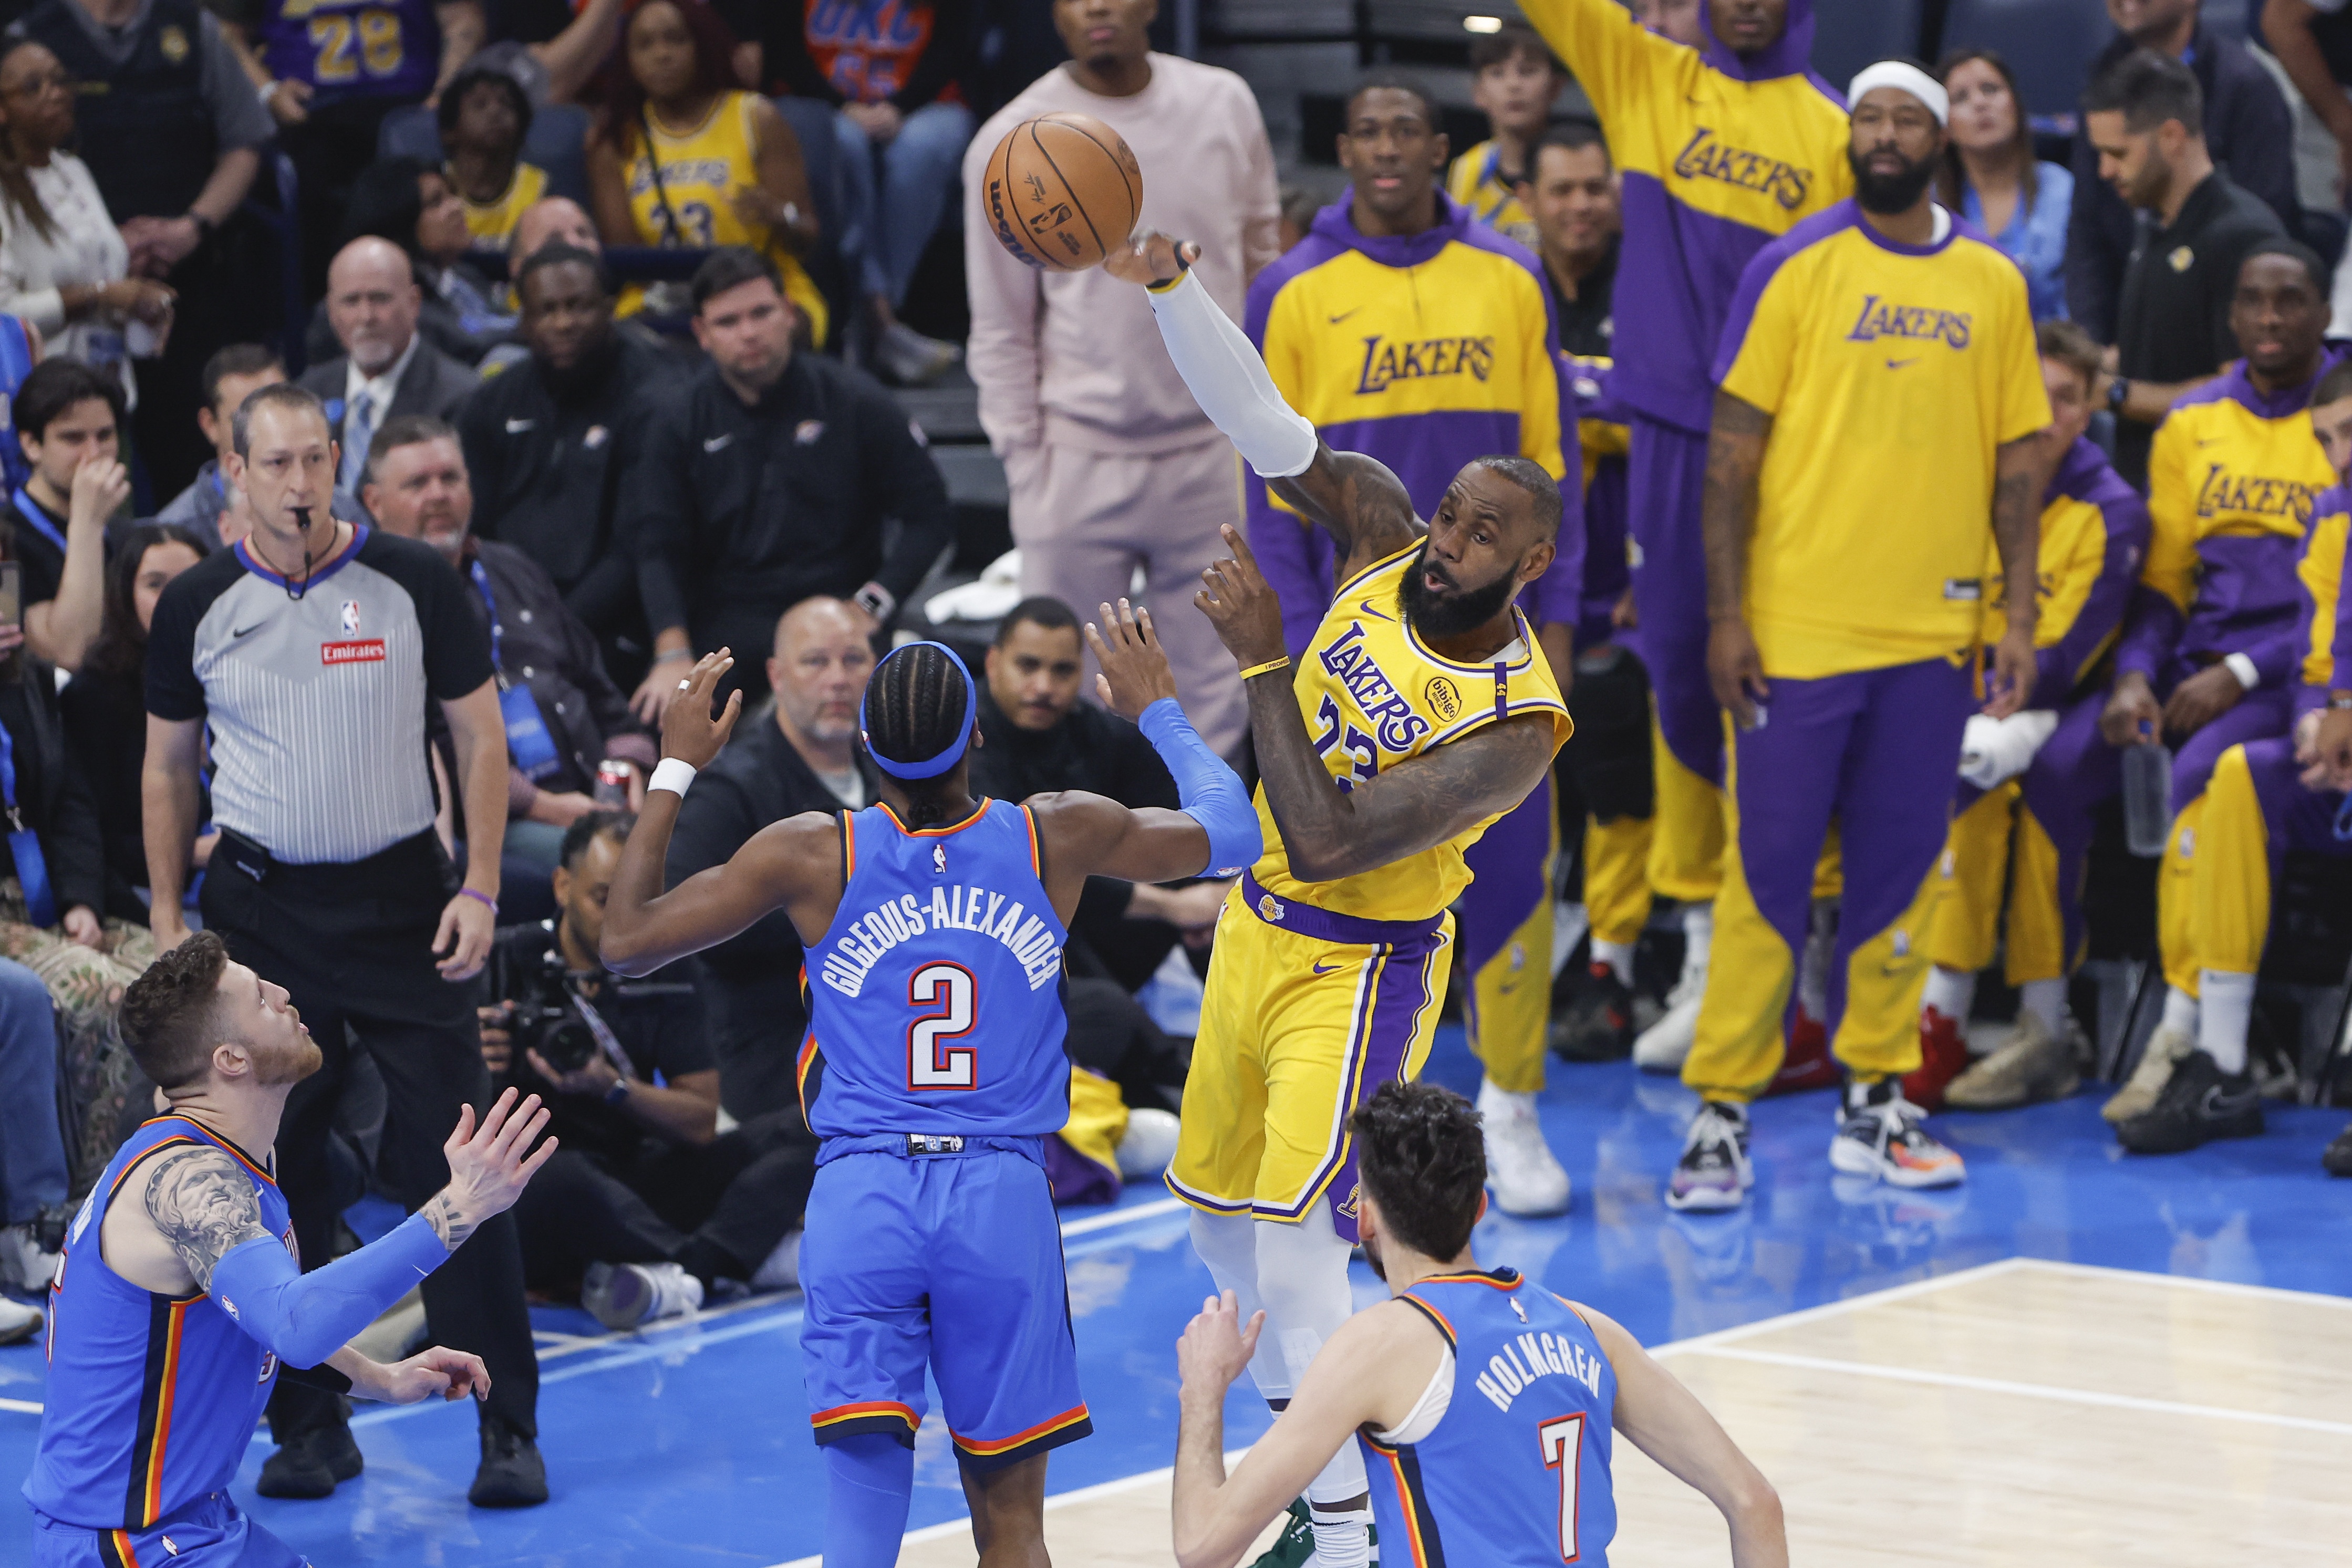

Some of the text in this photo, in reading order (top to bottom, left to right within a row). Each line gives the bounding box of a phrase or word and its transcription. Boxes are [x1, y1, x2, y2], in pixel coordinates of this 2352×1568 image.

[308, 9, 403, 83] 28
[1674, 126, 1814, 210] LAKERS
[1844, 295, 1972, 350] LAKERS
[1355, 336, 1495, 396] LAKERS
[323, 644, 384, 661] Emirates
[1318, 619, 1432, 754] LAKERS
[1497, 683, 1506, 697] 44
[1433, 680, 1456, 718] bibigo
[821, 885, 1061, 998] GILGEOUS-ALEXANDER
[907, 960, 978, 1092] 2
[1475, 1332, 1602, 1413] HOLMGREN
[1537, 1411, 1587, 1565] 7
